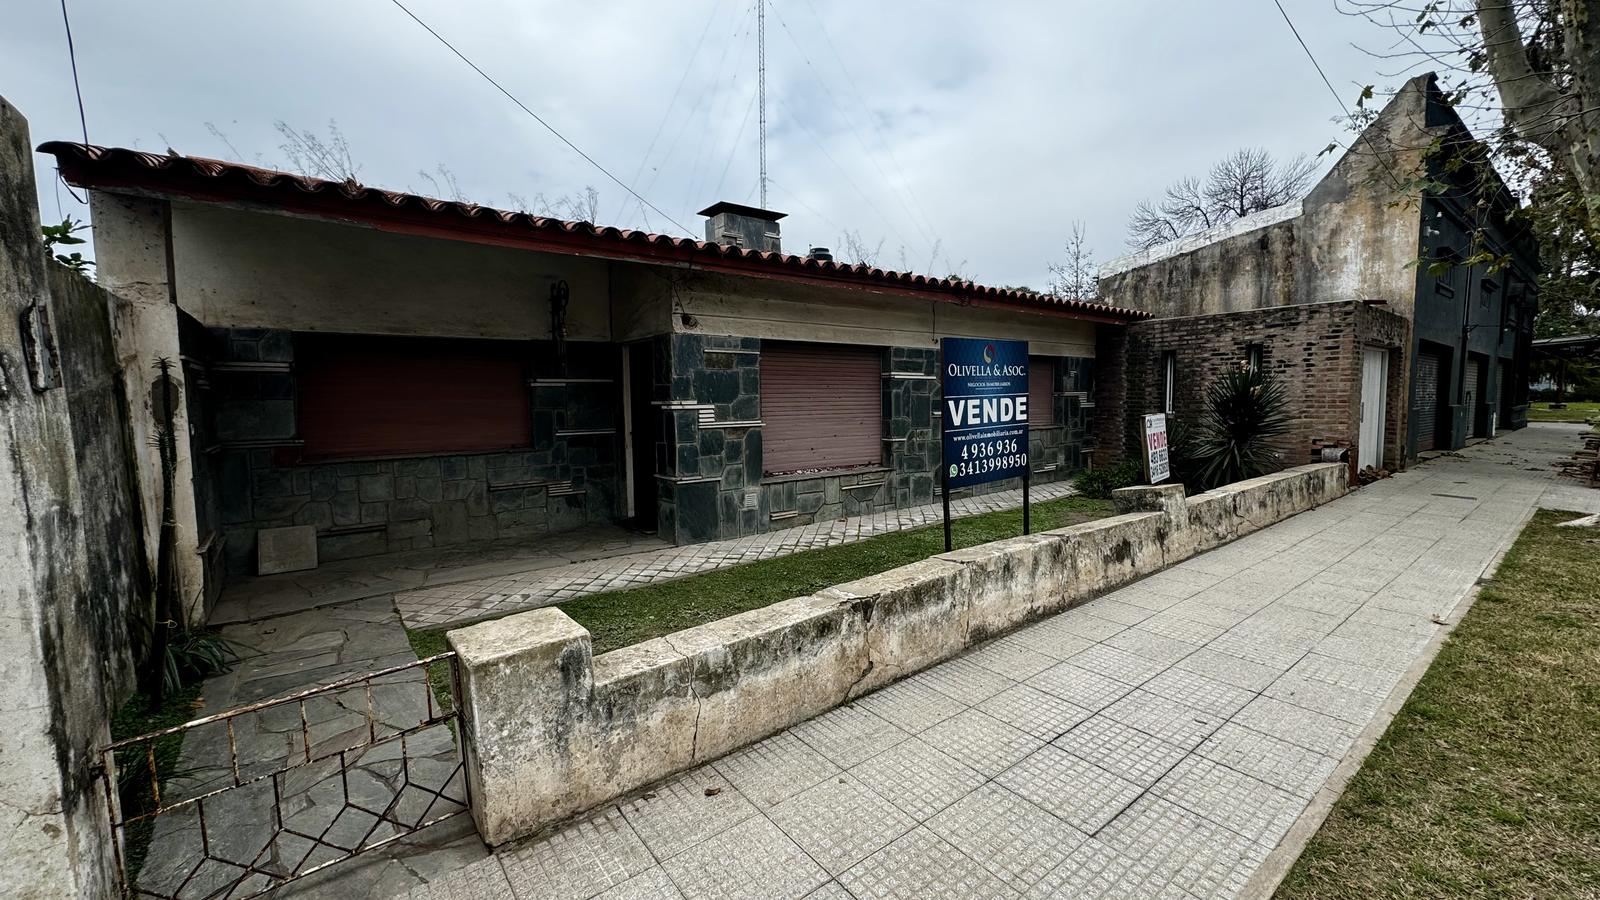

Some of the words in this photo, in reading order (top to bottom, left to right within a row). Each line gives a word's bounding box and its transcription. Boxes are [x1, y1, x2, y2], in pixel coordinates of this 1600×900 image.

[948, 363, 991, 376] OLIVELLA
[993, 363, 1001, 376] &
[1001, 364, 1026, 376] ASOC.
[948, 396, 1027, 426] VENDE
[953, 429, 1023, 441] www.olivellainmobiliaria.com.ar
[1148, 431, 1167, 450] VENDE
[959, 453, 1027, 477] 3413998950
